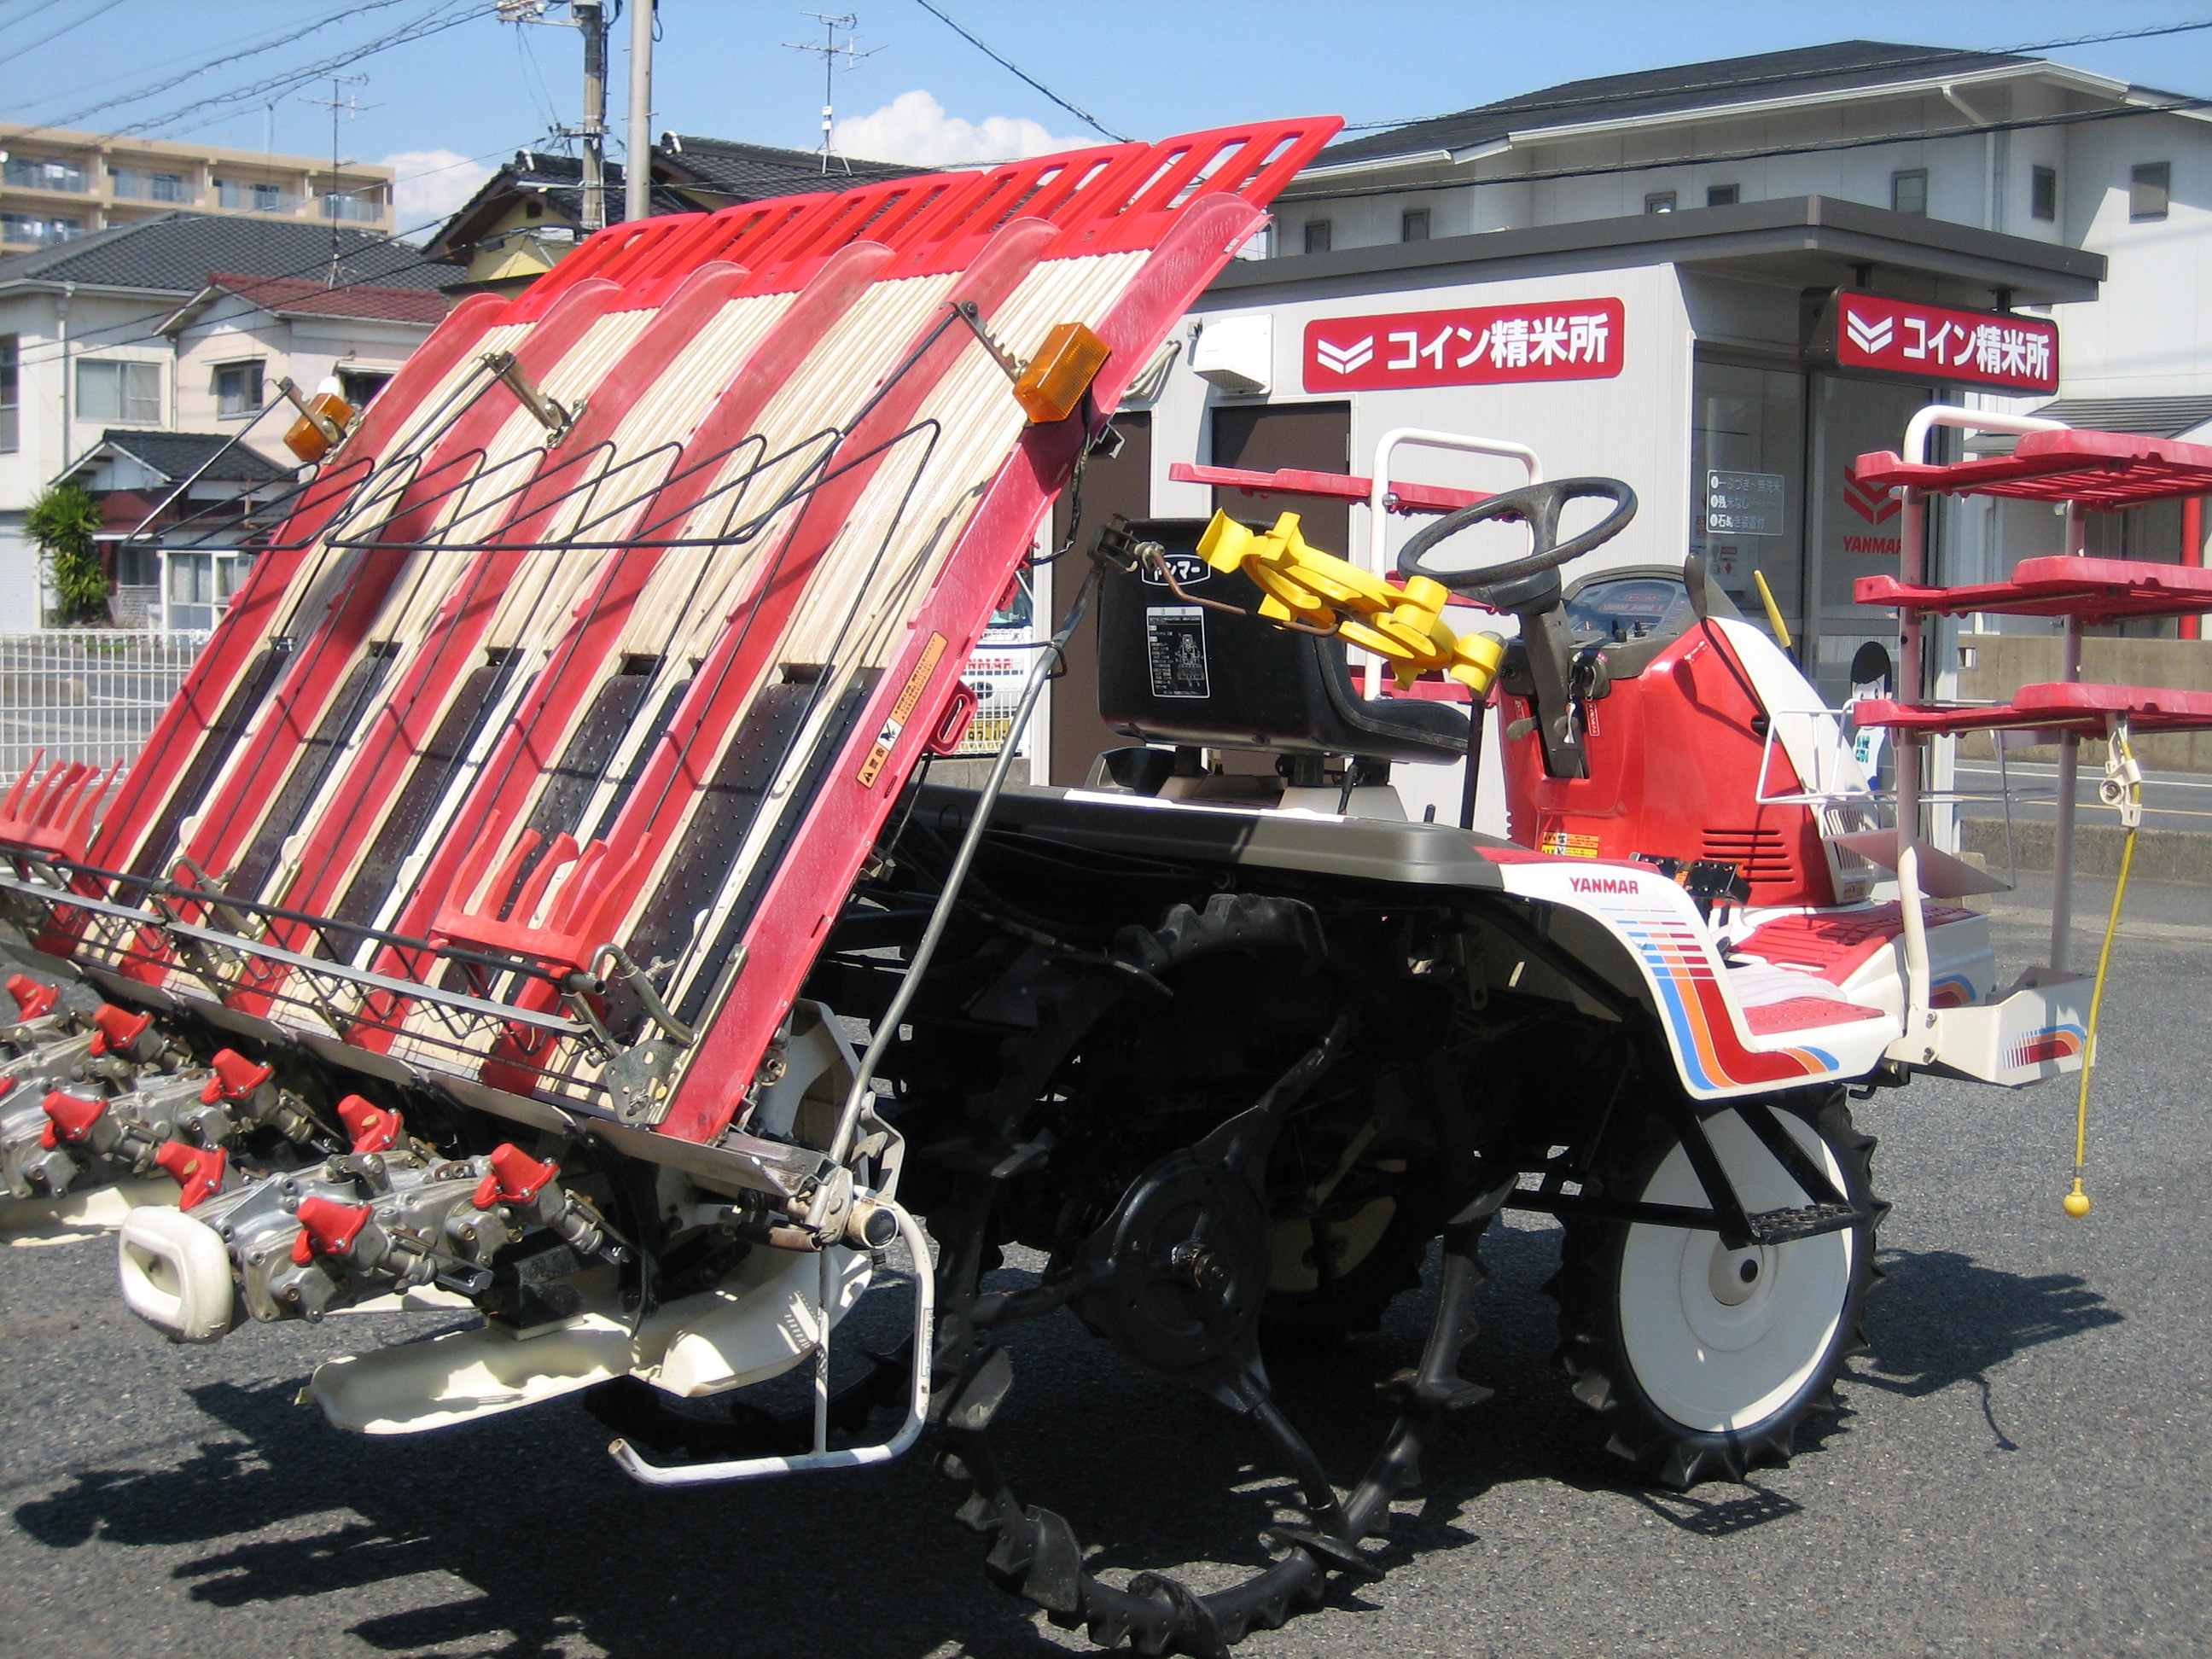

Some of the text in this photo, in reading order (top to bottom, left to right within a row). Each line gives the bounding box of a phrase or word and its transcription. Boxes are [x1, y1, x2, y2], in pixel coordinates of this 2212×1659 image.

[1388, 312, 1609, 370] コイン精米所
[1903, 317, 2050, 381] コイン精米所
[1842, 536, 1901, 555] YANMA
[1569, 876, 1639, 894] YANMAR
